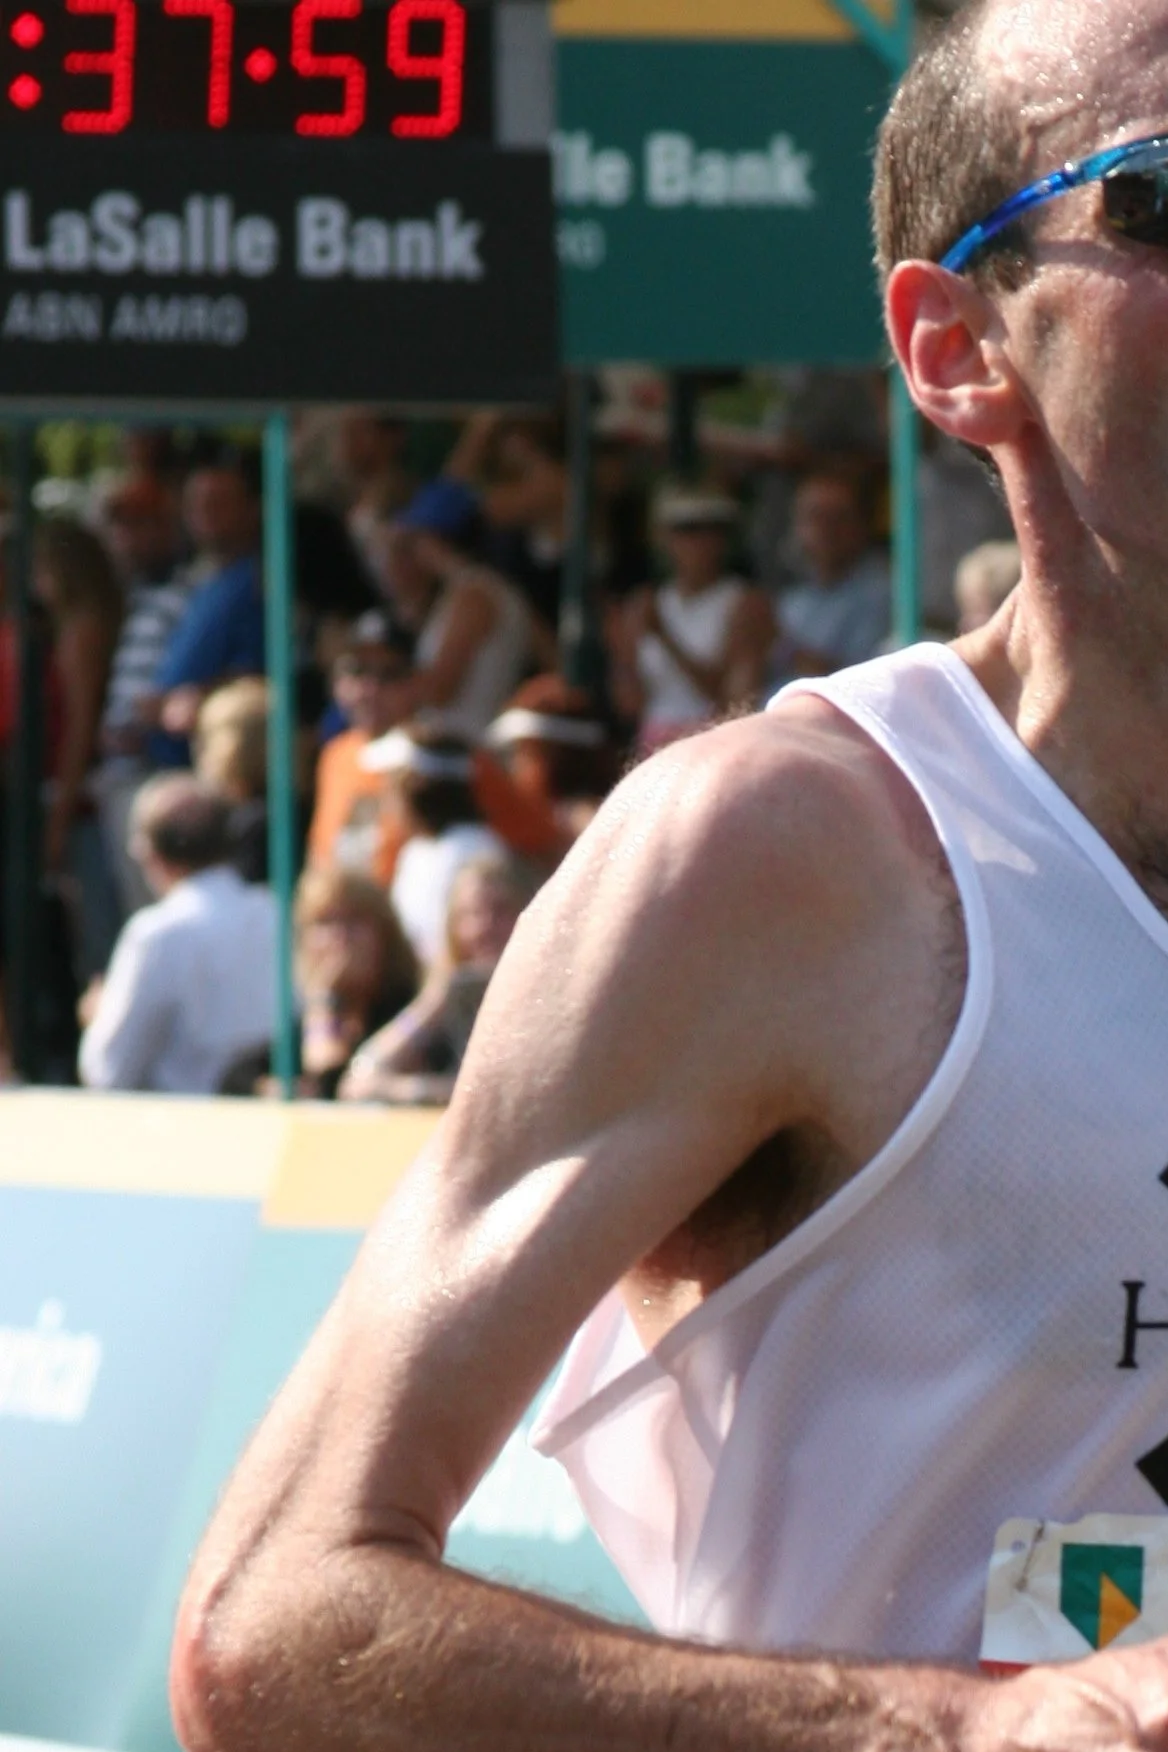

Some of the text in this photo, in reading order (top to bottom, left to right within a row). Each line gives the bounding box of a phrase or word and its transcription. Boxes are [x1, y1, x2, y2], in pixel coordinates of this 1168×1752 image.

[645, 130, 814, 208] Bank
[5, 191, 279, 277] LaSalle
[297, 196, 485, 281] Bank
